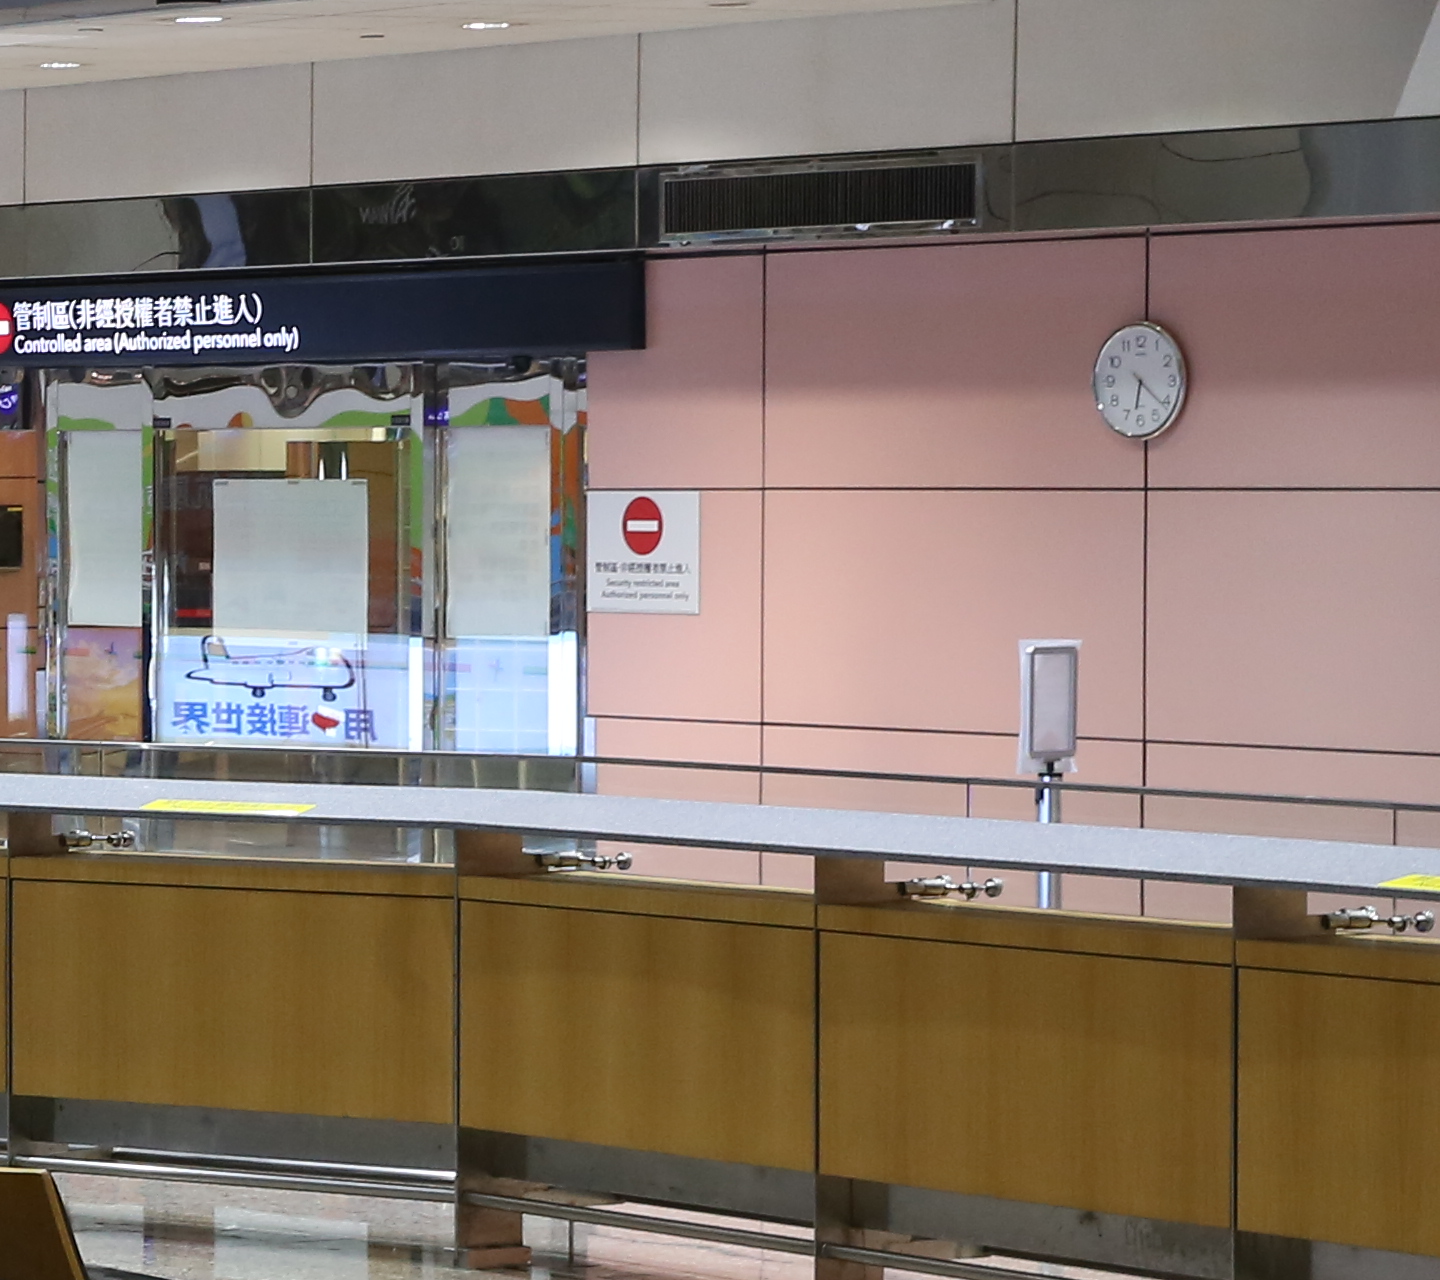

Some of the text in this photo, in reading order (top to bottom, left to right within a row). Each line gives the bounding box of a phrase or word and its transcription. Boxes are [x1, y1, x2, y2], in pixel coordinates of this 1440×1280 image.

[13, 333, 81, 354] Controlled
[84, 336, 112, 352] area
[193, 329, 262, 354] personnel
[264, 326, 299, 352] only)
